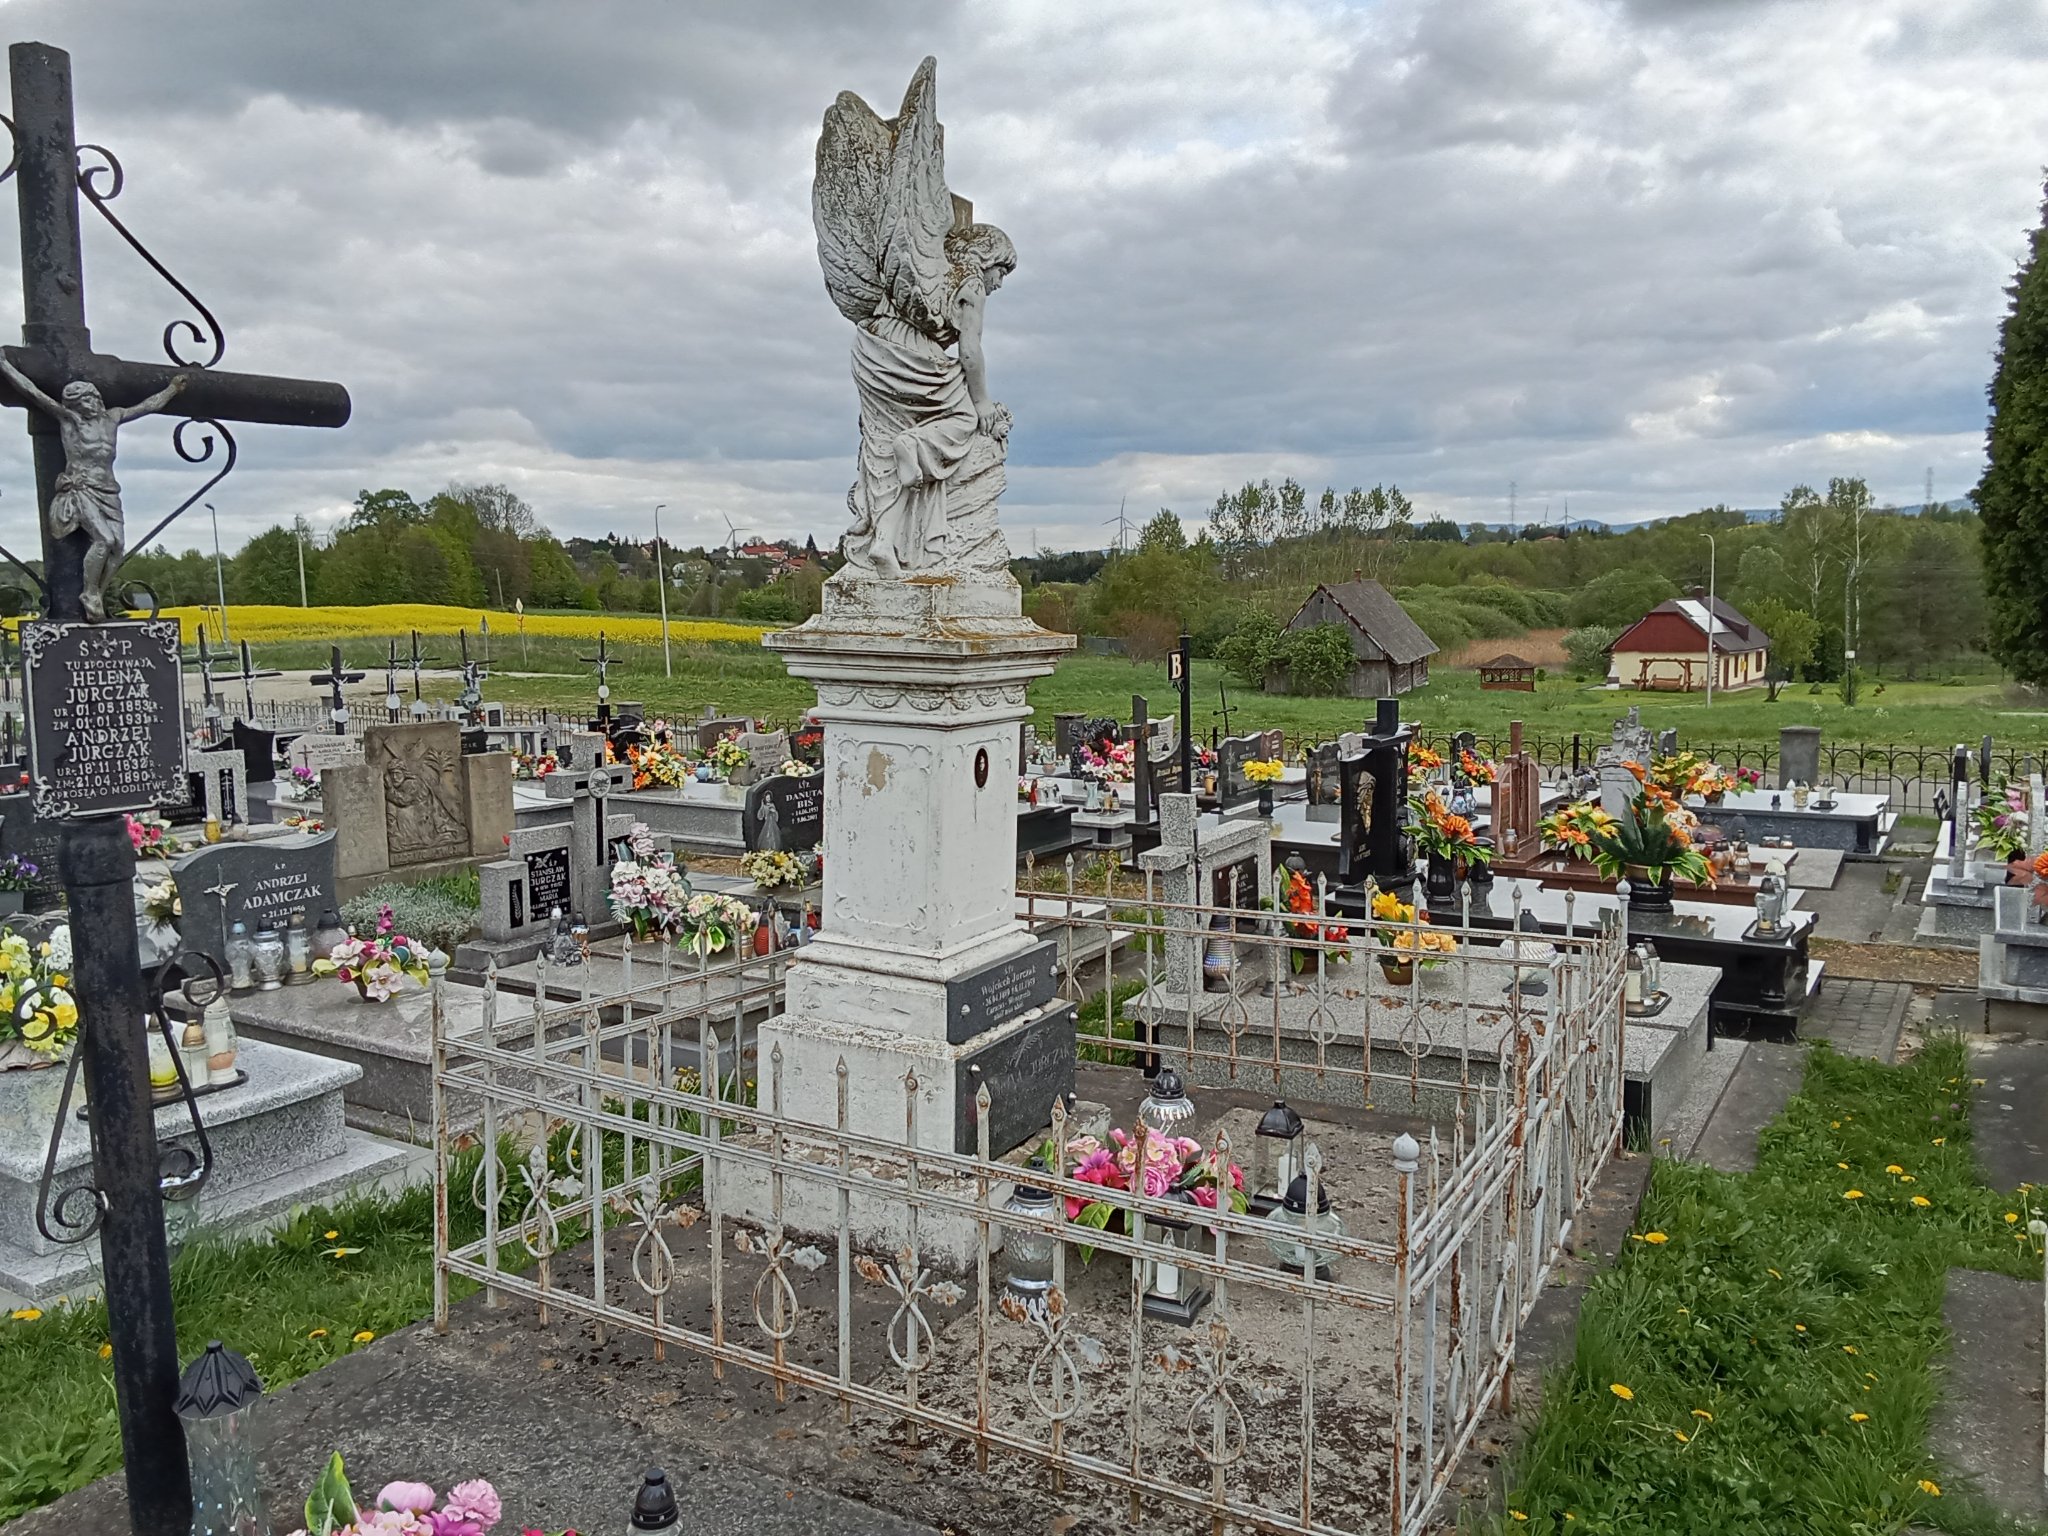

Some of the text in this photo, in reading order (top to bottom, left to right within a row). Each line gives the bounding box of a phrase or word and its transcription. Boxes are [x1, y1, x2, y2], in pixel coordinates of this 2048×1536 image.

[1171, 653, 1182, 679] B
[72, 668, 146, 687] HELENA
[65, 683, 150, 704] JURCZAK
[65, 726, 151, 746] ANDRZEJ
[100, 787, 108, 796] O
[785, 788, 823, 802] DANUTA
[254, 872, 308, 892] ANDRZEJ
[529, 872, 567, 887] JURCZAK
[242, 884, 323, 910] ADAMCZAK
